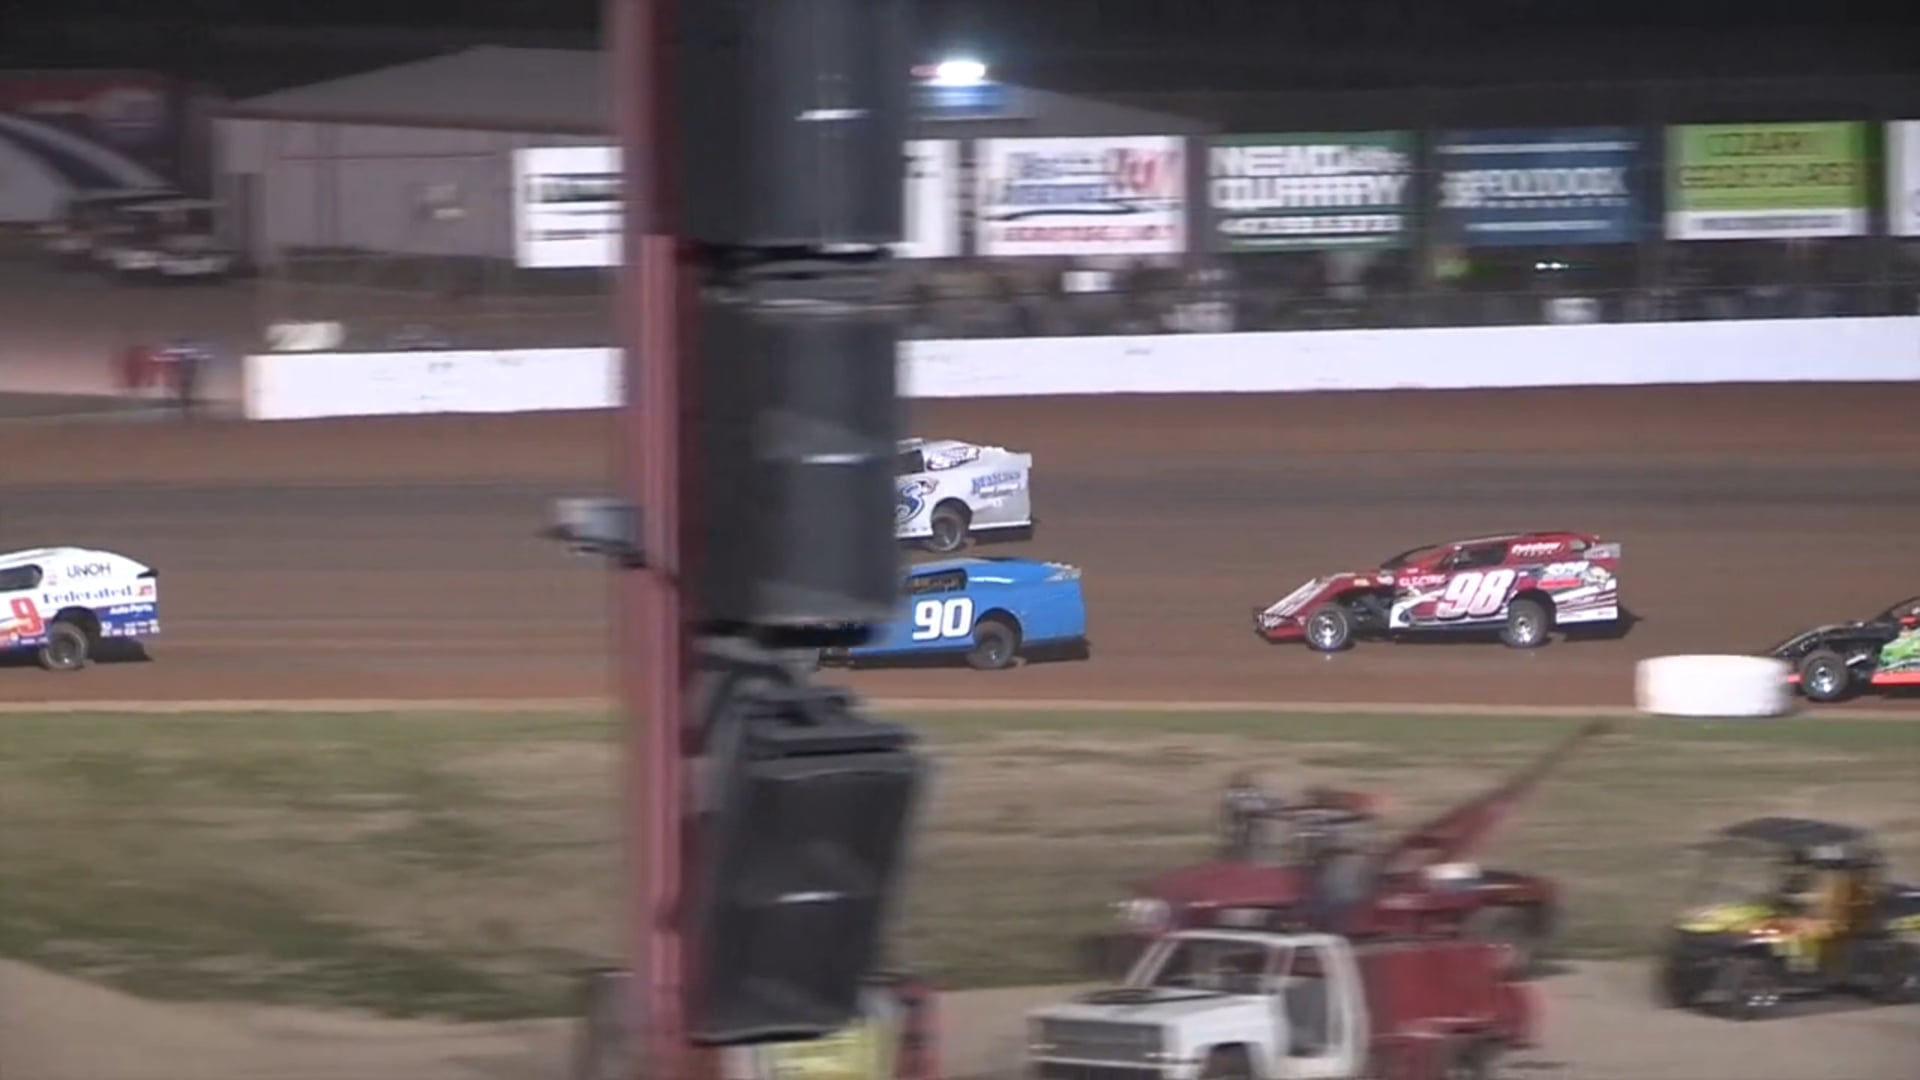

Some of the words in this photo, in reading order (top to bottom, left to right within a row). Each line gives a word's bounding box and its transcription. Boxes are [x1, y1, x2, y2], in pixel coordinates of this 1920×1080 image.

[66, 562, 112, 578] UNOH
[43, 585, 132, 604] Federated
[1436, 569, 1514, 619] 98
[9, 597, 44, 636] 9
[911, 598, 975, 640] 90
